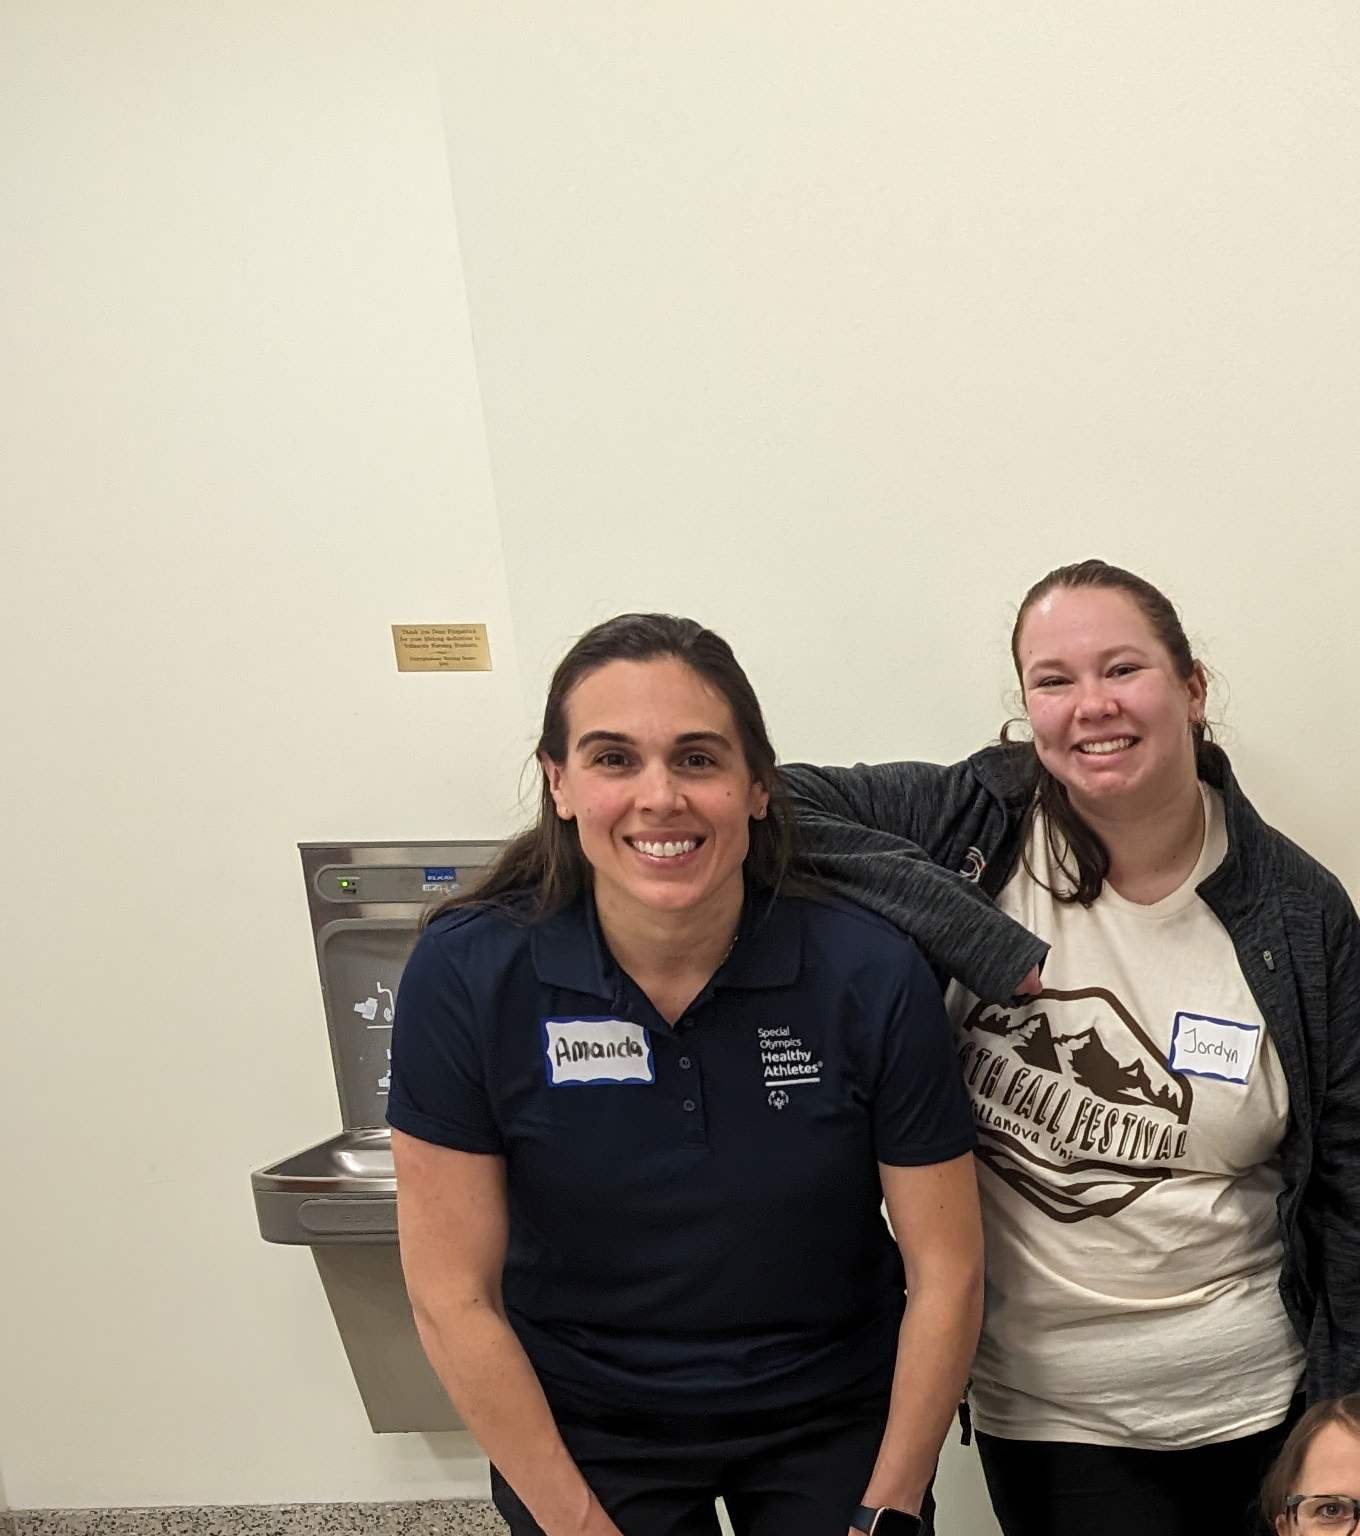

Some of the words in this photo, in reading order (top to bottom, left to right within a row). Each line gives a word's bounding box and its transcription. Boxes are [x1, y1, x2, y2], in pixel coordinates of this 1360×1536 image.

[758, 1025, 791, 1039] Special
[555, 1035, 645, 1068] Amanda
[760, 1037, 803, 1051] Olympics
[1184, 1027, 1240, 1065] Jordyn
[761, 1048, 812, 1064] Healthy
[764, 1062, 819, 1078] Athletes
[1001, 1066, 1072, 1135] FALL
[1064, 1097, 1189, 1162] FESTIVAL
